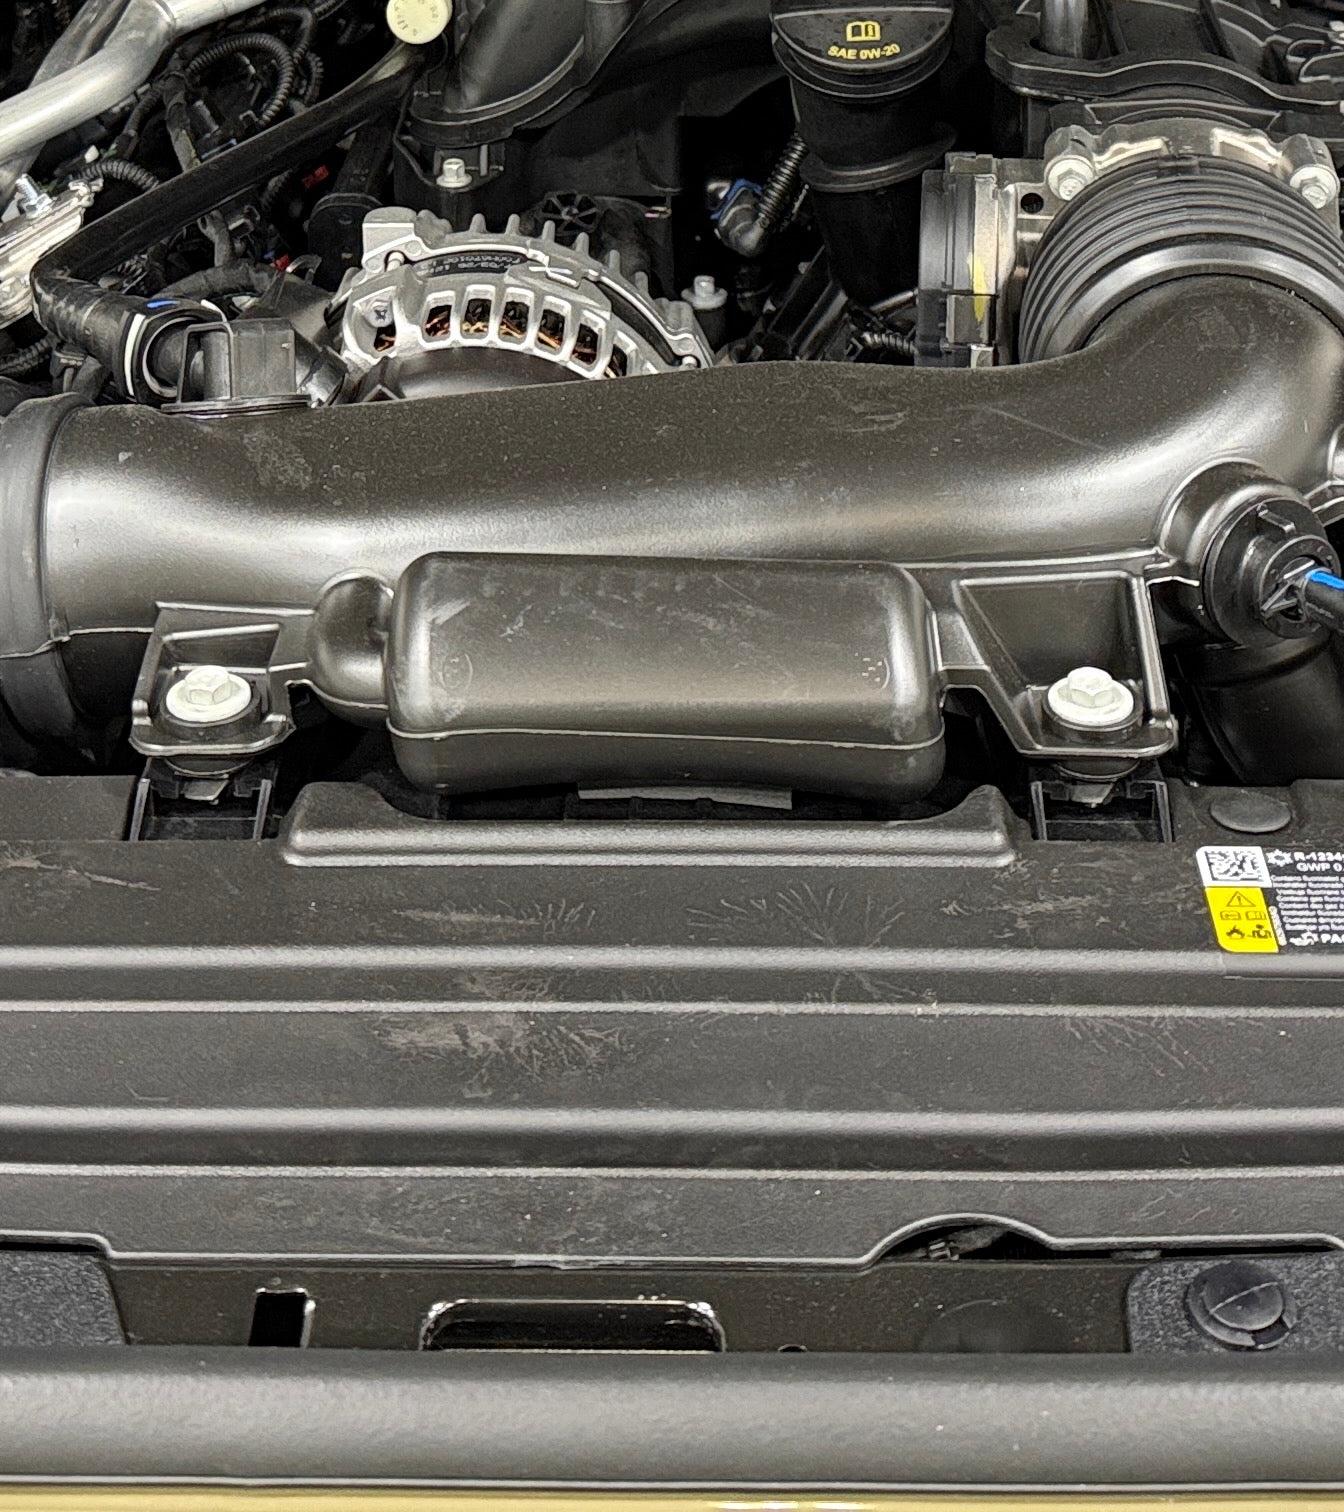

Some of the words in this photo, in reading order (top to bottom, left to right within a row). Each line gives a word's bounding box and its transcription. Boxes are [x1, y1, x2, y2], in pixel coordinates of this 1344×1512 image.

[827, 45, 857, 60] SAE
[859, 43, 901, 60] 0W-20
[1296, 862, 1331, 872] GWP
